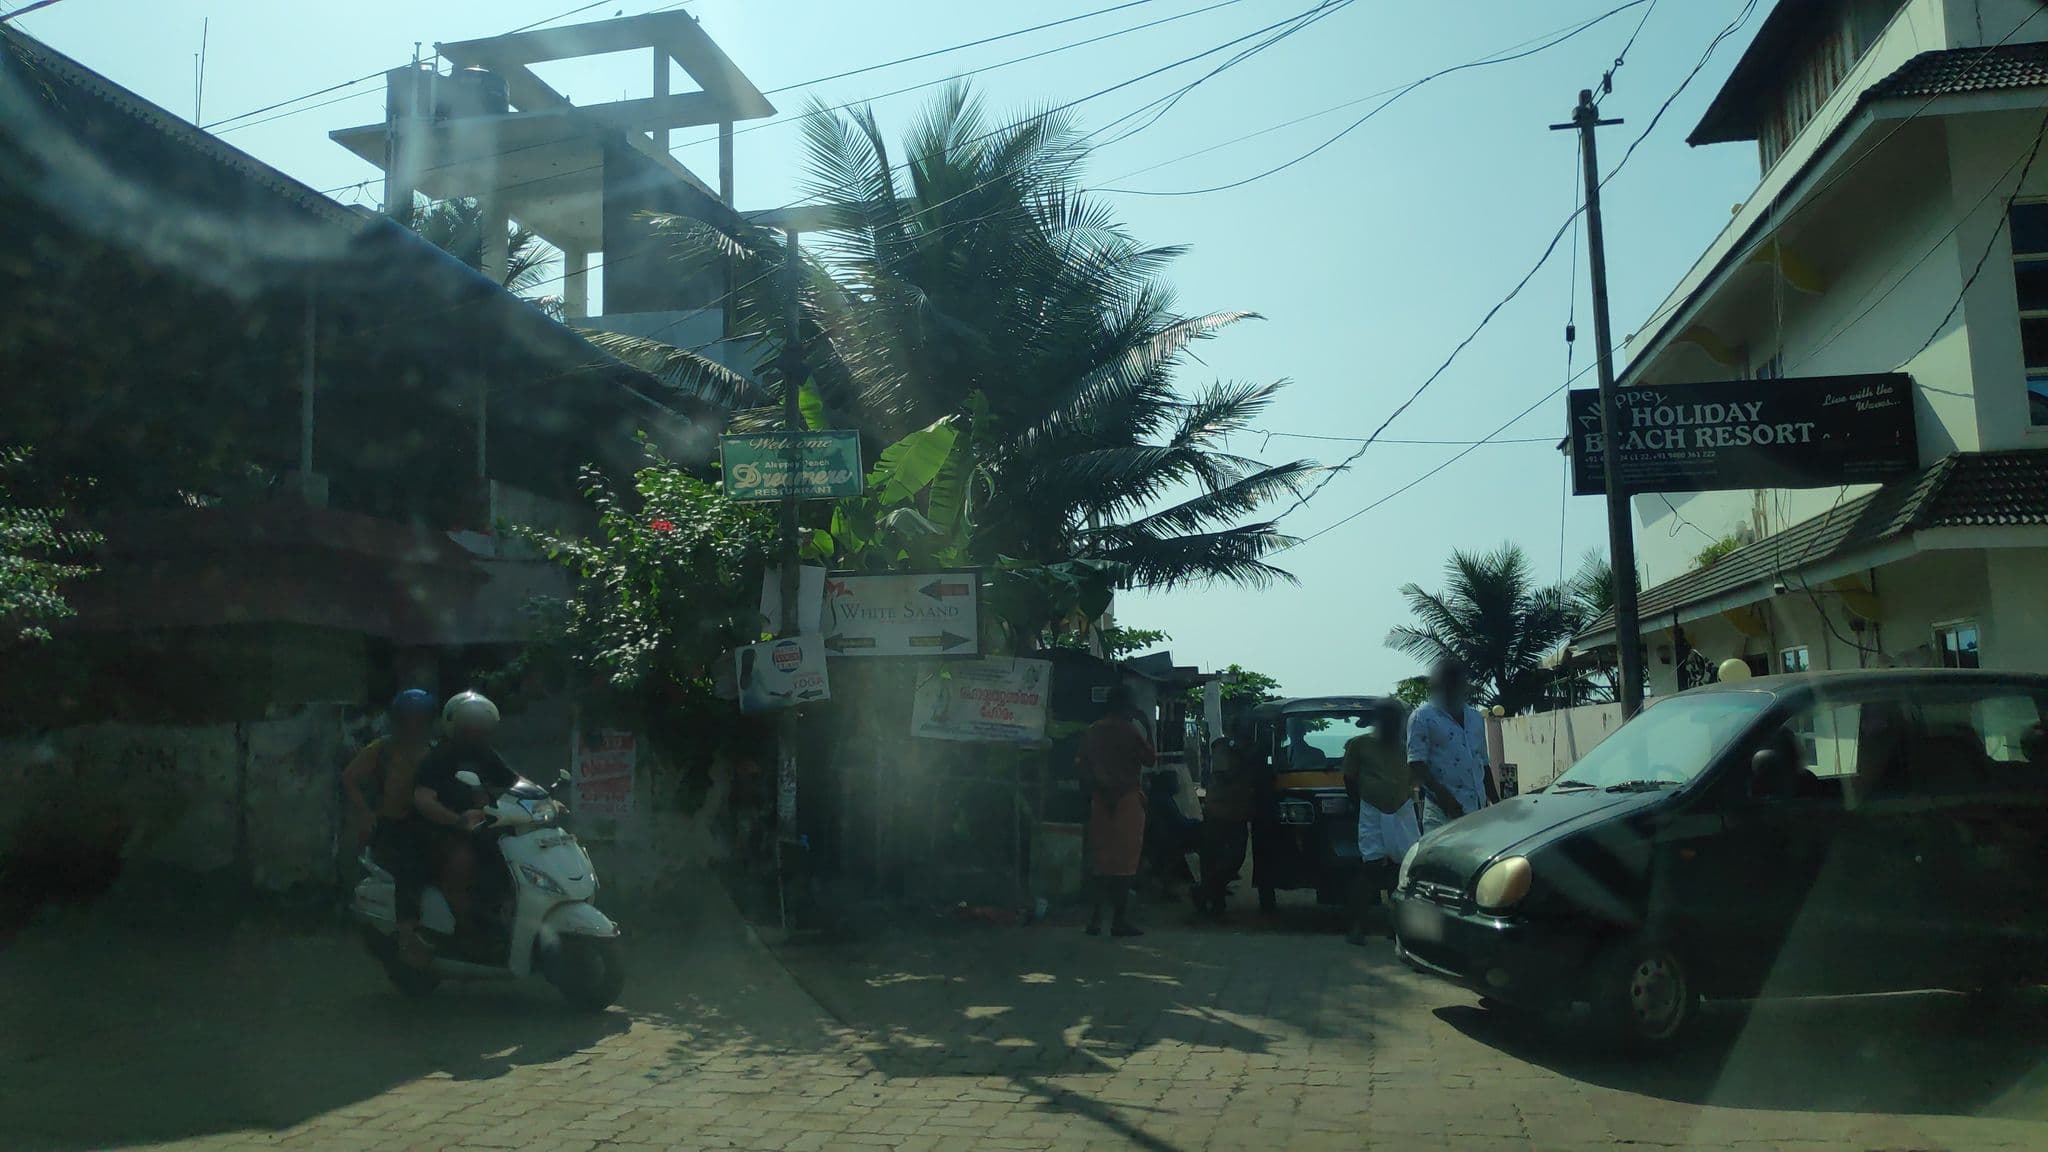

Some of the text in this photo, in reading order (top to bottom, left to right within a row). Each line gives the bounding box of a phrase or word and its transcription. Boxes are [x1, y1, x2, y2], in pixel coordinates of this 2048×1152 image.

[1849, 386, 1874, 401] with
[1876, 383, 1894, 396] the
[1578, 390, 1668, 428] Allppey
[1631, 401, 1763, 427] HOLIDAY
[749, 436, 833, 450] Welcome
[1695, 421, 1815, 448] RESORT
[792, 677, 825, 689] YOGA
